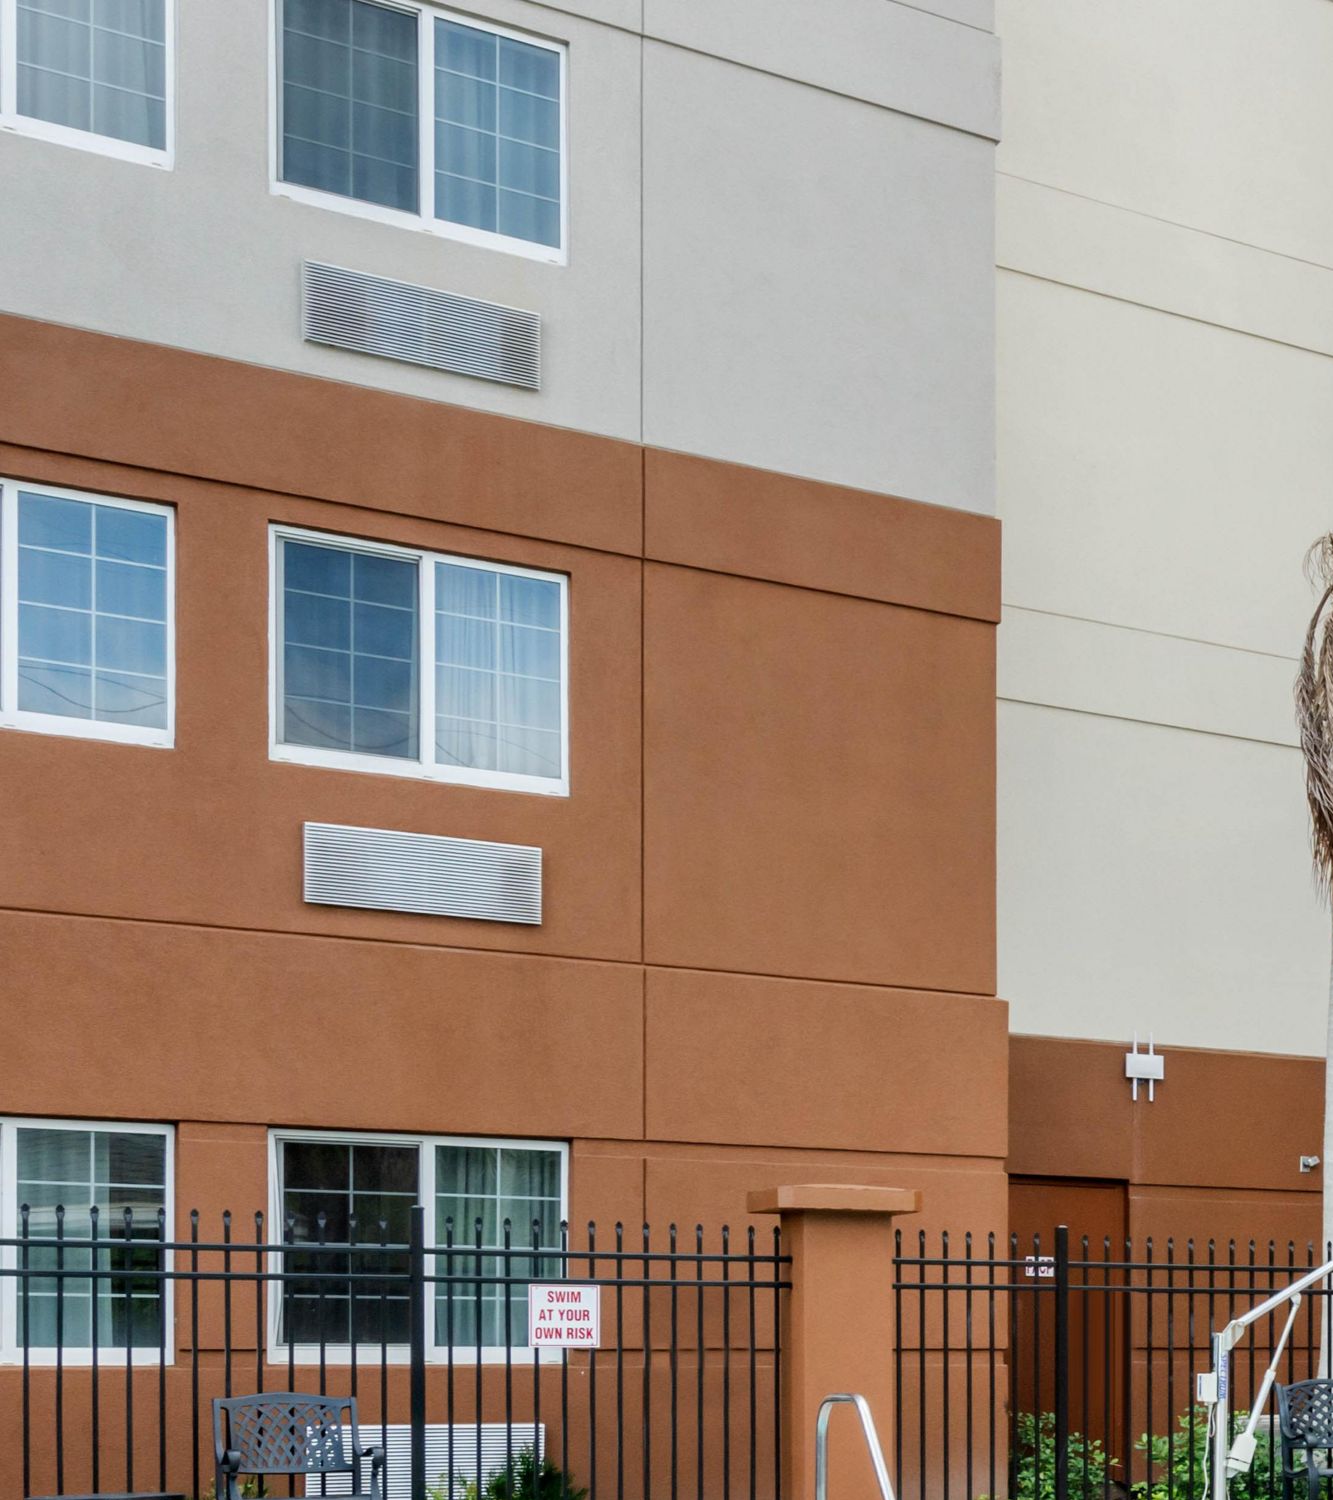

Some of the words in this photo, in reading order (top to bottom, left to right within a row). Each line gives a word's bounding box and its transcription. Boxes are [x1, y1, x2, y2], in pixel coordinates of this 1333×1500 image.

[547, 1290, 581, 1303] SWIM
[539, 1309, 554, 1321] AT
[558, 1309, 590, 1321] YOUR
[535, 1327, 562, 1339] OWN
[566, 1327, 593, 1339] RISK
